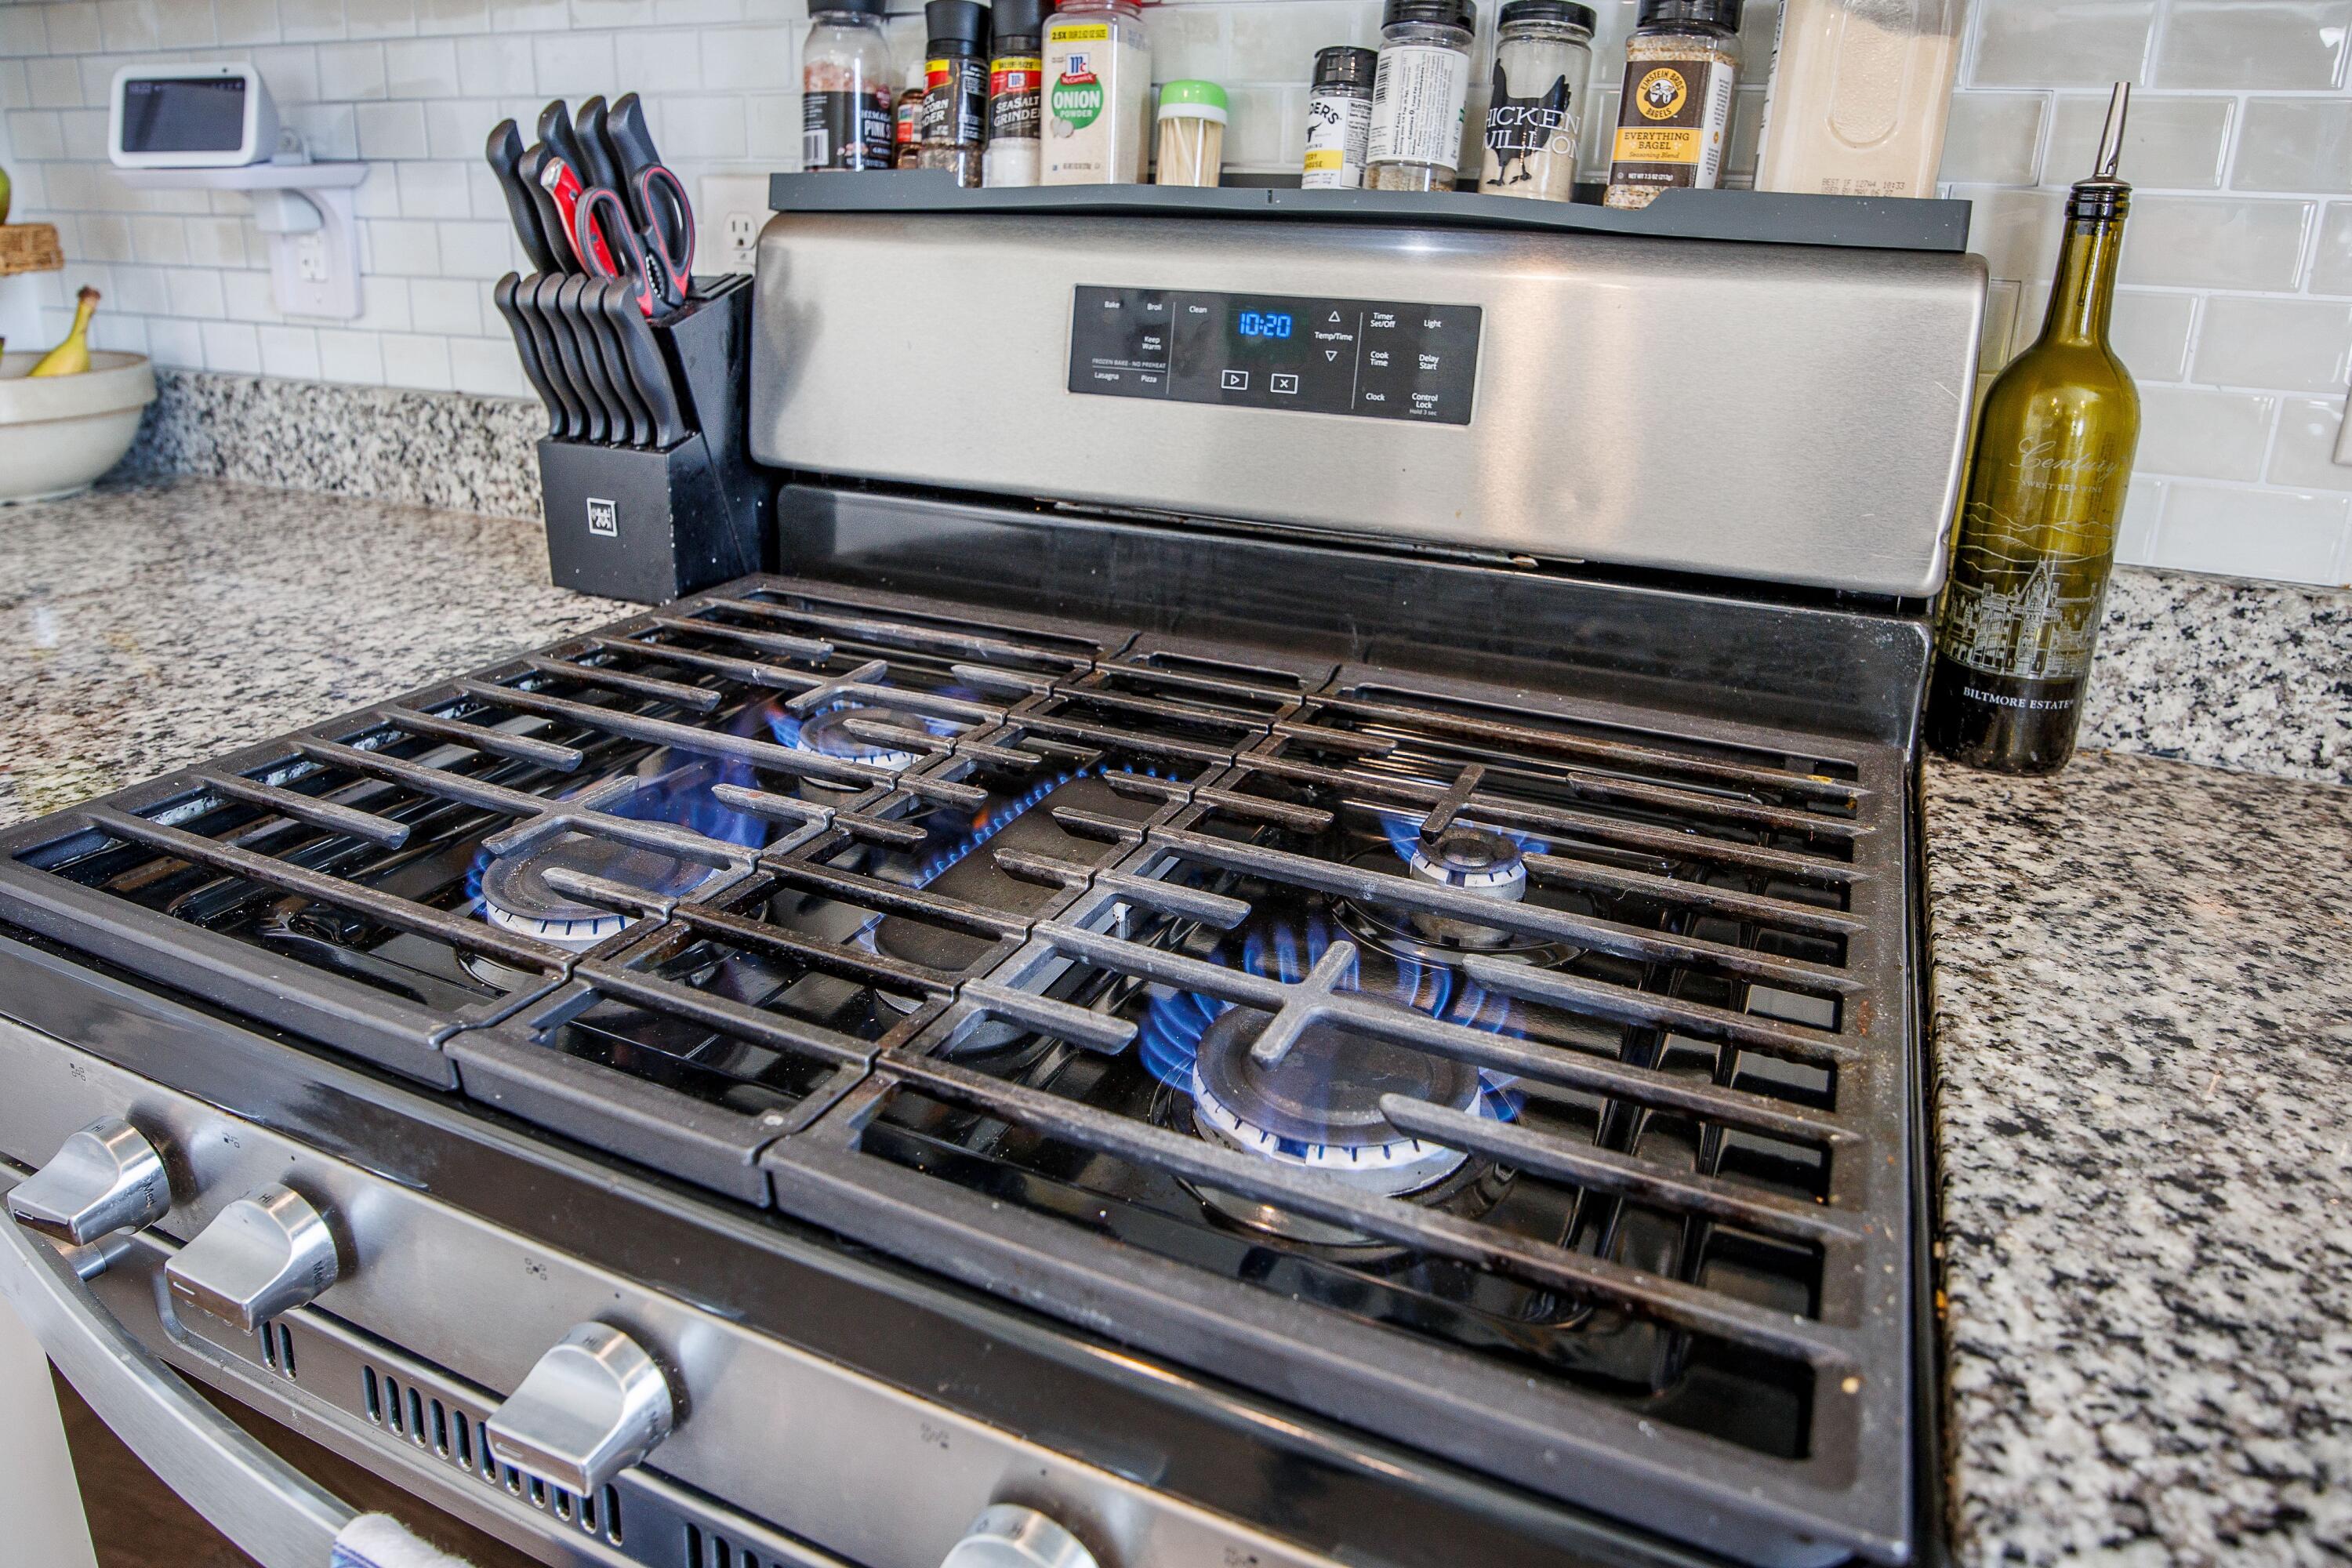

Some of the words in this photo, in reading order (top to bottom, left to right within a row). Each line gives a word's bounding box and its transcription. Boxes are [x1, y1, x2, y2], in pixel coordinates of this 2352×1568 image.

[1639, 71, 1668, 91] EINSTEIN
[1669, 73, 1685, 91] BROS
[1053, 90, 1101, 109] ONION
[1646, 107, 1672, 118] BAGELS
[1624, 132, 1690, 141] EVERYTHING
[1639, 141, 1671, 150] BAGEL
[1821, 177, 1840, 187] BEST
[1104, 300, 1120, 309] Bake
[1147, 303, 1163, 311] Broil
[1189, 305, 1207, 314] Clean
[1373, 312, 1394, 321] Timer
[1240, 312, 1291, 339] 10:20
[1370, 319, 1396, 328] Set/Off
[1424, 319, 1442, 329] Light
[1144, 336, 1160, 345] Keep
[1314, 331, 1353, 341] Temp/Time
[1370, 350, 1389, 359] Cook
[1418, 354, 1439, 364] Delay
[1142, 361, 1167, 369] PREHEAT
[1370, 358, 1388, 367] Time
[1419, 361, 1437, 370] Start
[1094, 372, 1120, 381] Lasagna
[1141, 375, 1157, 383] Pizza
[1365, 393, 1385, 401] Clock
[1411, 393, 1439, 402] Control
[1415, 401, 1432, 409] Lock
[2020, 480, 2055, 490] SWEET
[1963, 687, 2027, 708] BILTMORE
[2029, 699, 2070, 710] ESTATE
[93, 1124, 106, 1133] Hi
[258, 1193, 274, 1203] Hi
